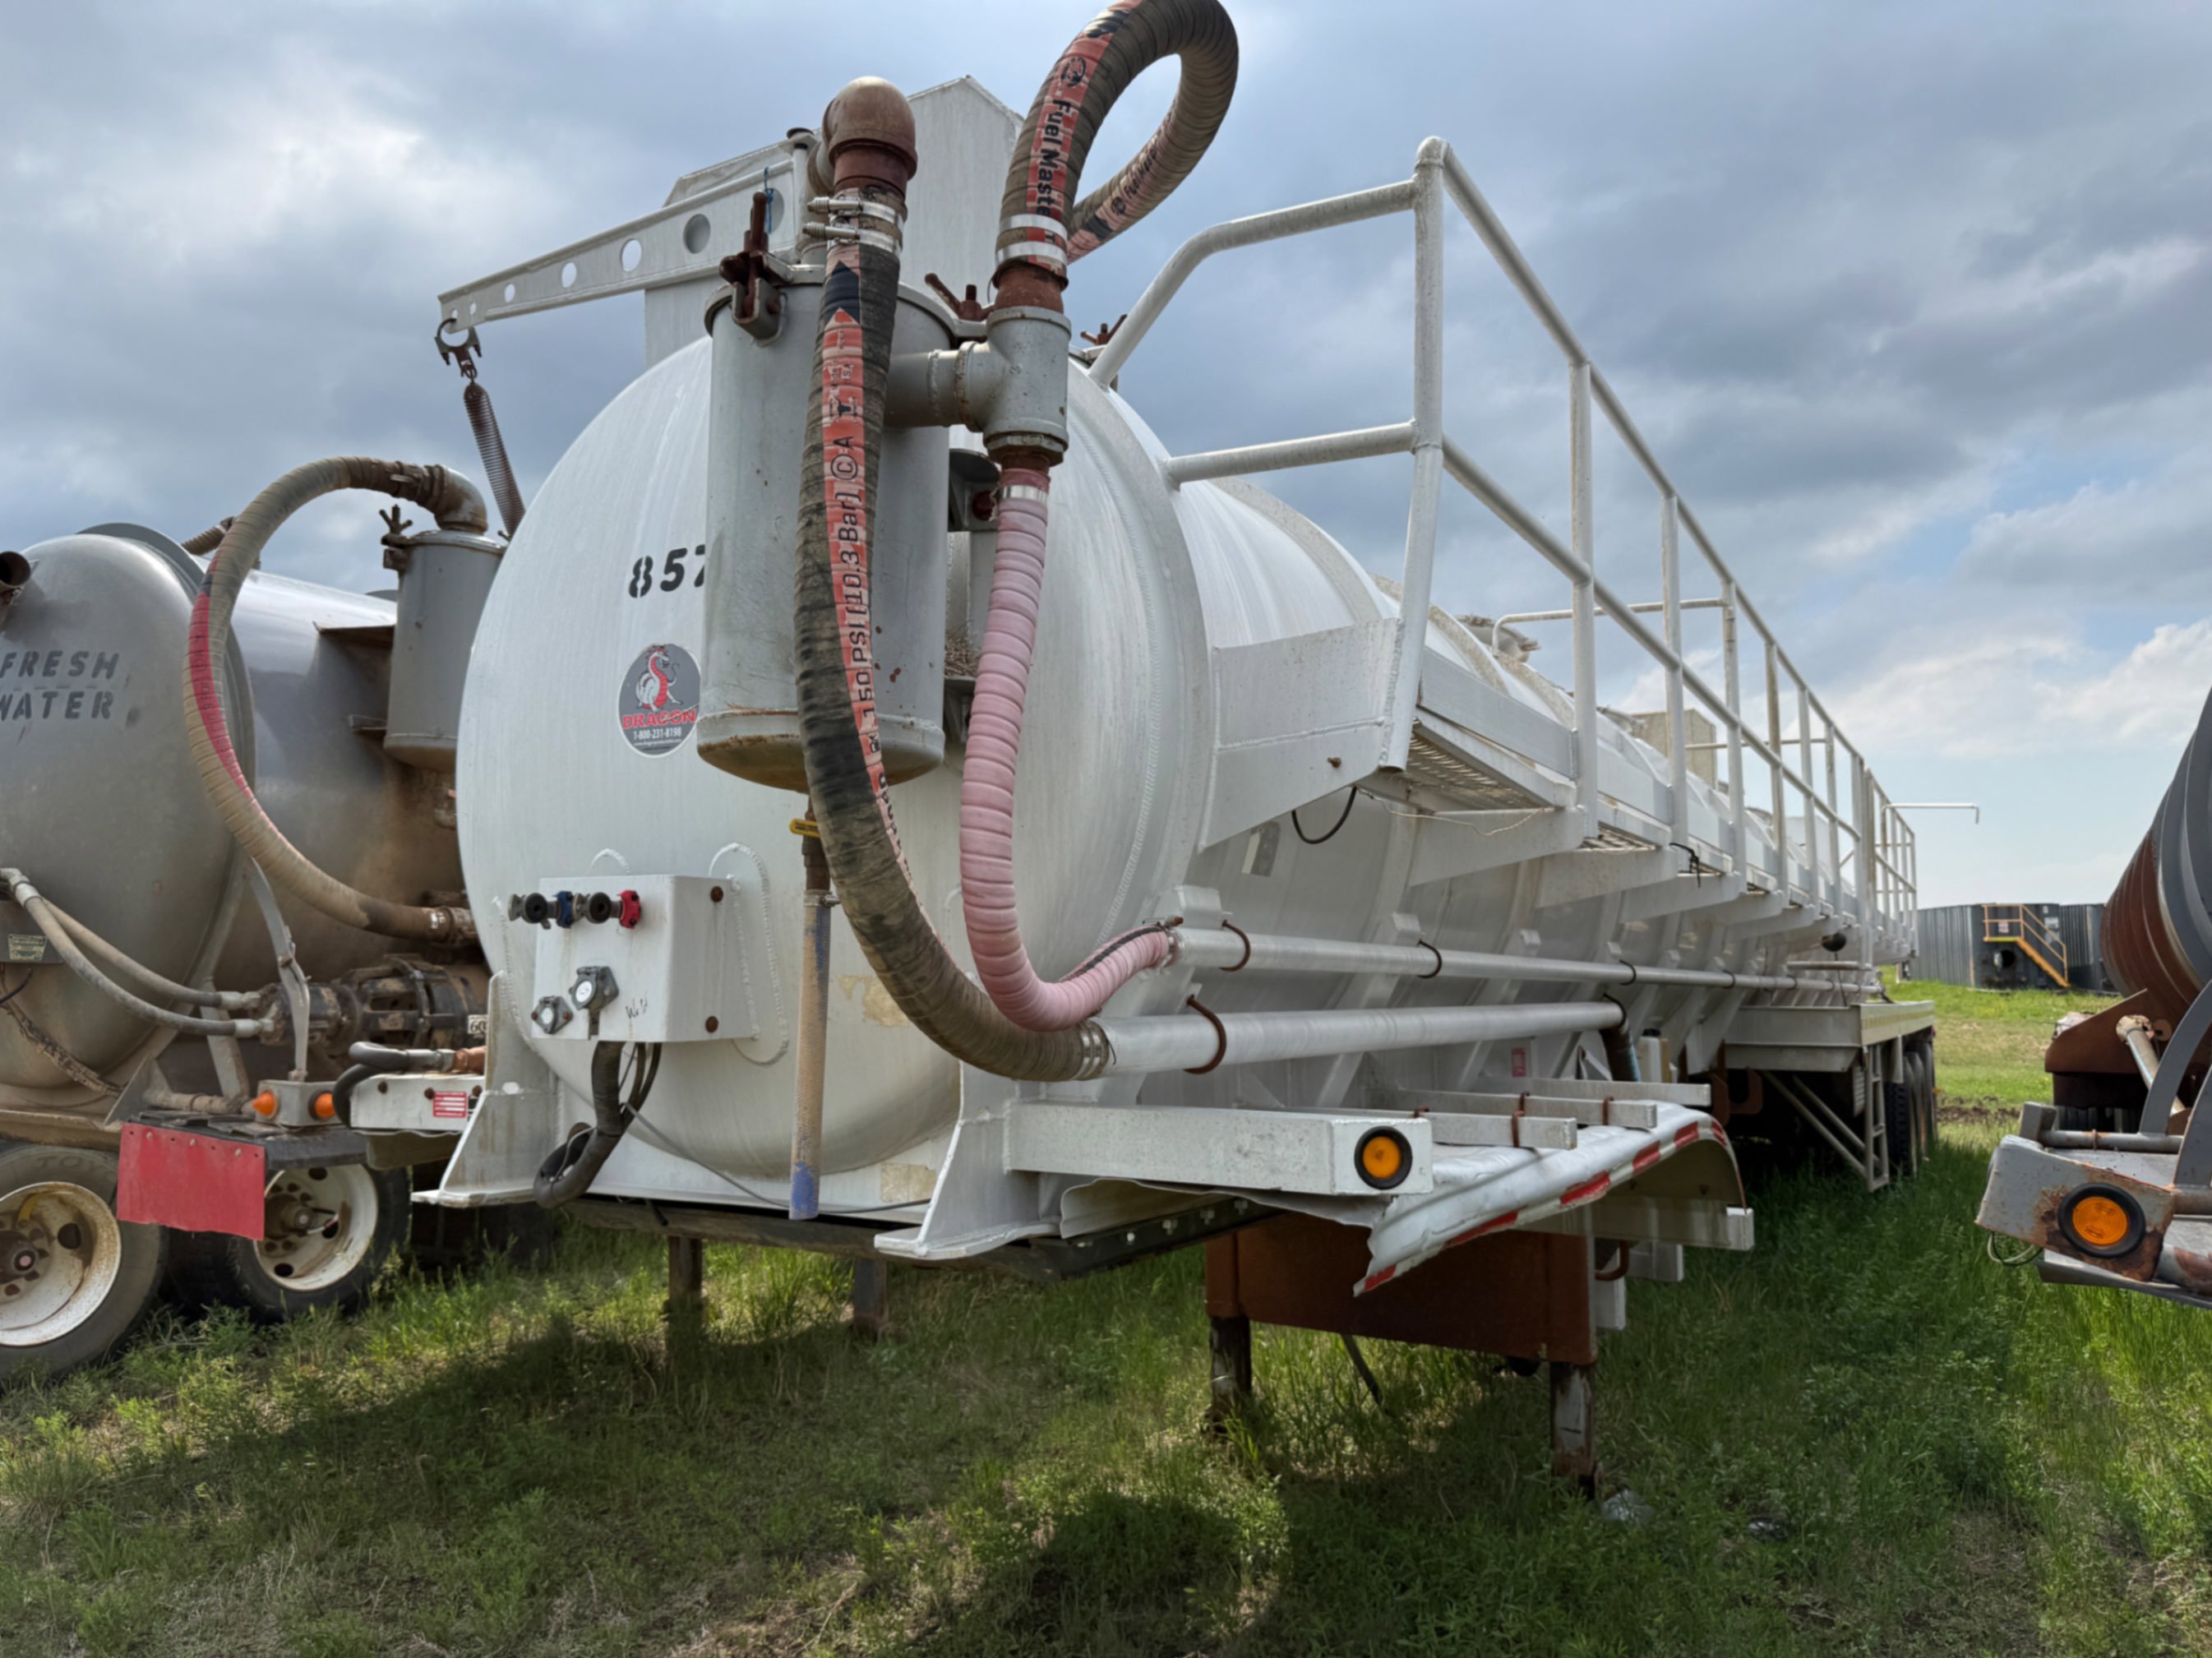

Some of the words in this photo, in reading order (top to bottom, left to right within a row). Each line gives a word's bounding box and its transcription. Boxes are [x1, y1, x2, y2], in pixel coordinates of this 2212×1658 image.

[1042, 99, 1071, 146] Fuel
[1035, 148, 1060, 217] Maste
[0, 650, 119, 680] FRESH
[848, 624, 869, 663] PSI
[856, 671, 875, 718] 150
[622, 709, 697, 729] DRAGON
